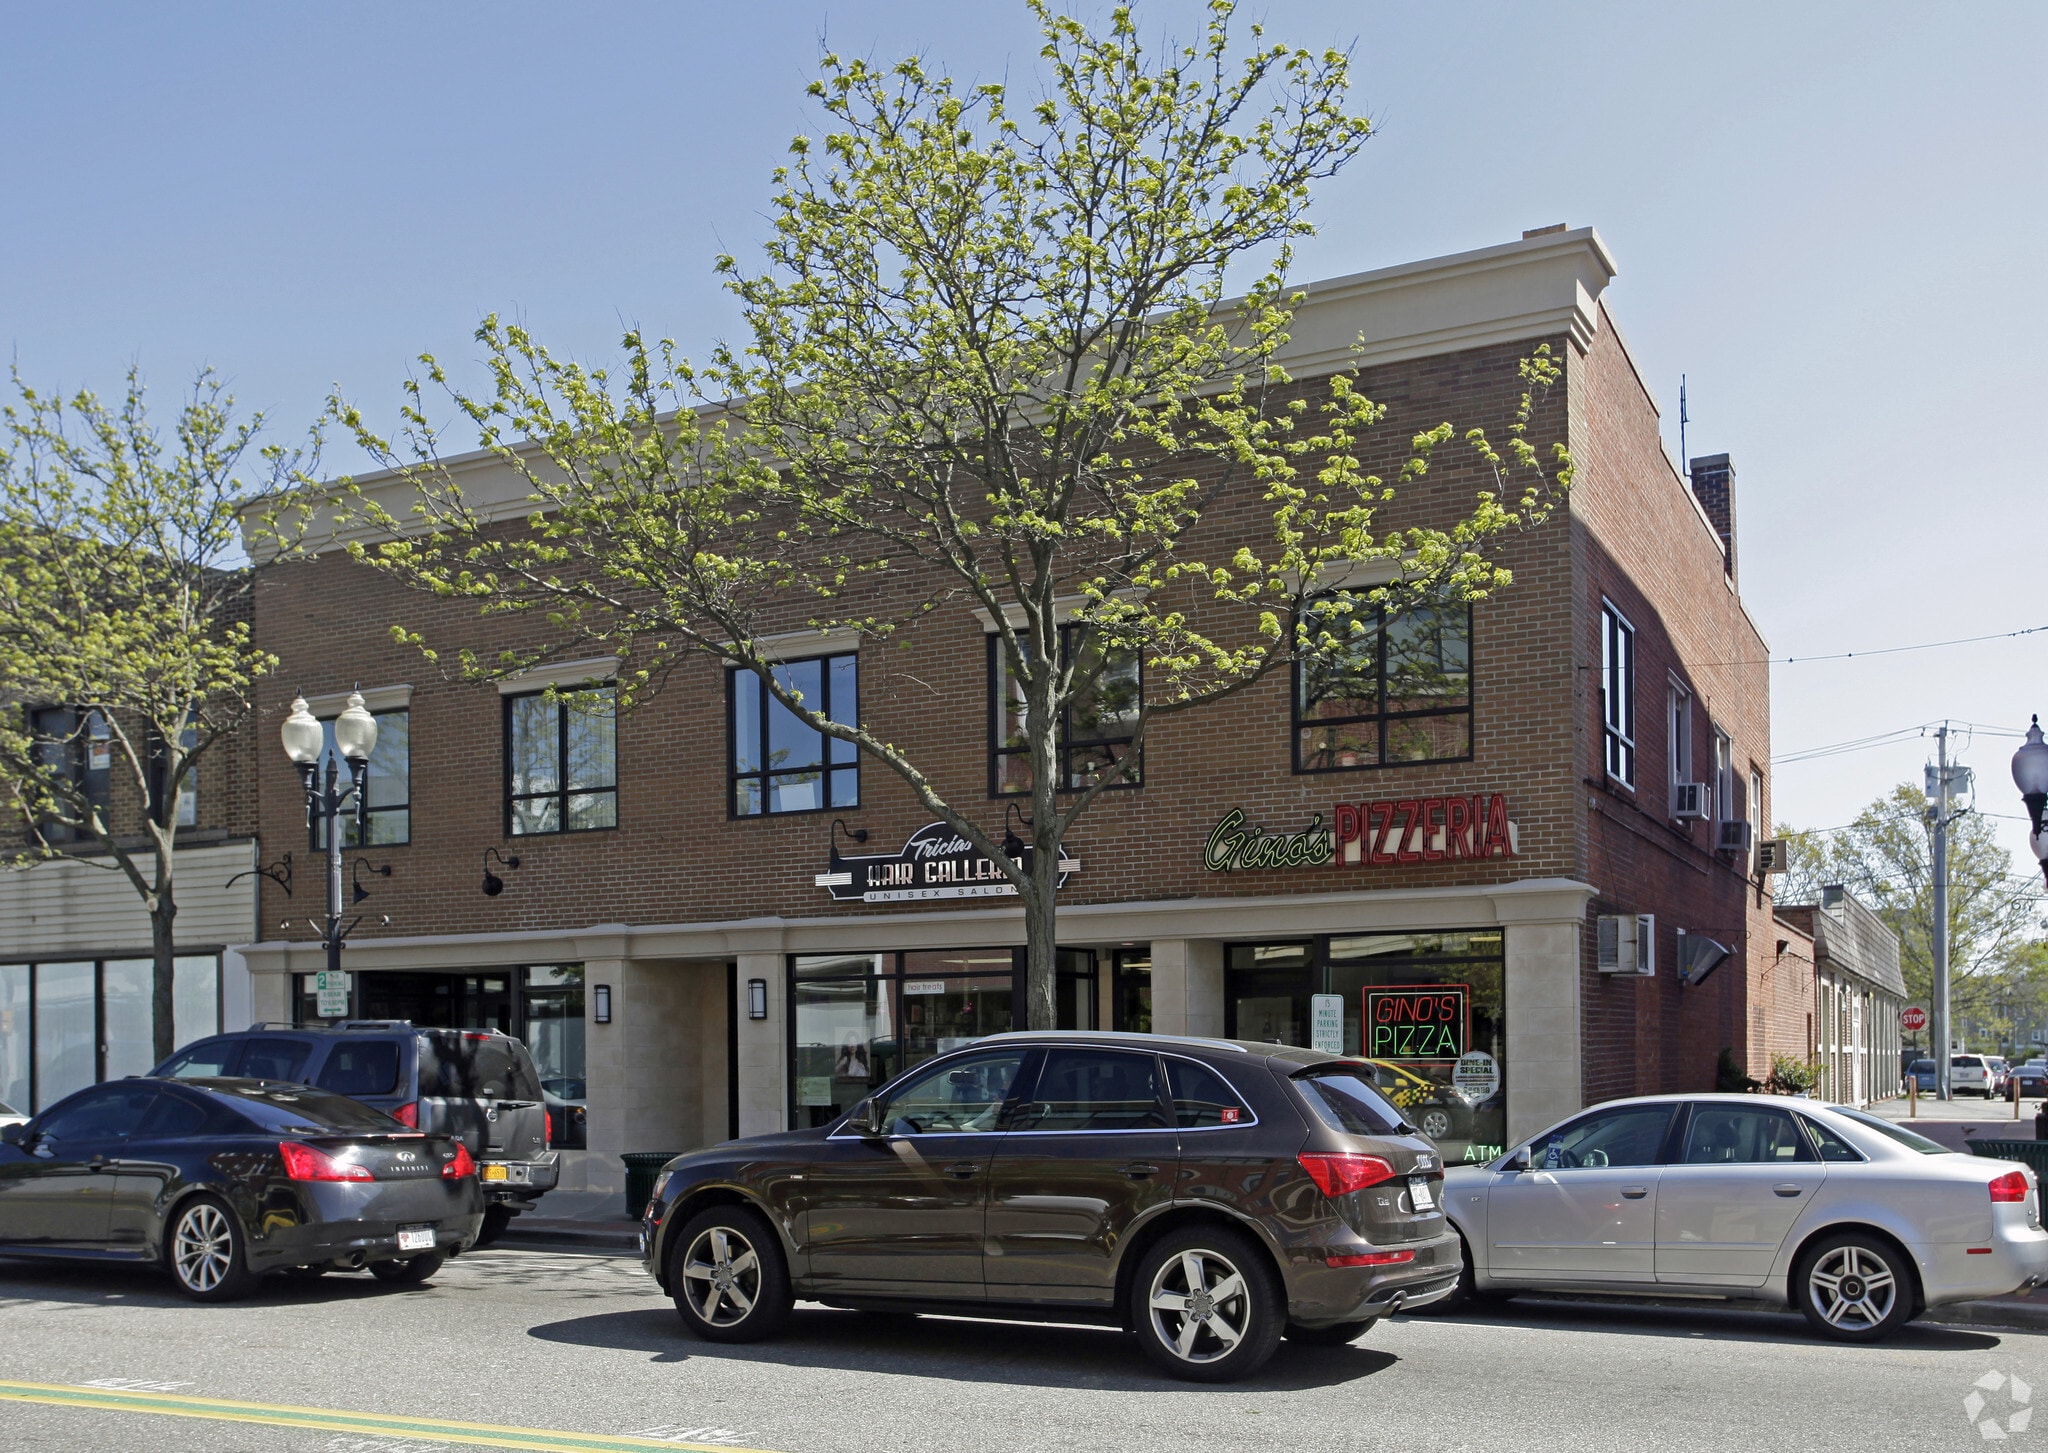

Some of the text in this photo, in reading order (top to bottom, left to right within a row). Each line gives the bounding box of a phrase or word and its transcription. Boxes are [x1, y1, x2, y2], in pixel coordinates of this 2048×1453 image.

[1204, 794, 1516, 872] Gino's PIZZERIA
[910, 835, 973, 861] Tricias
[867, 856, 1023, 887] HAIR GALLER
[869, 890, 940, 901] UNISEX
[318, 975, 326, 987] 2
[1318, 1009, 1337, 1018] MINUTE
[1376, 996, 1456, 1023] GINO'S
[1316, 1019, 1339, 1028] PARKING
[1902, 1013, 1925, 1025] STOP
[1315, 1030, 1339, 1039] STRICTLY
[1375, 1024, 1457, 1056] PIZZA
[1314, 1040, 1341, 1050] ENFORCED
[1459, 1066, 1494, 1075] SPECIAL
[1463, 1144, 1503, 1161] ATM
